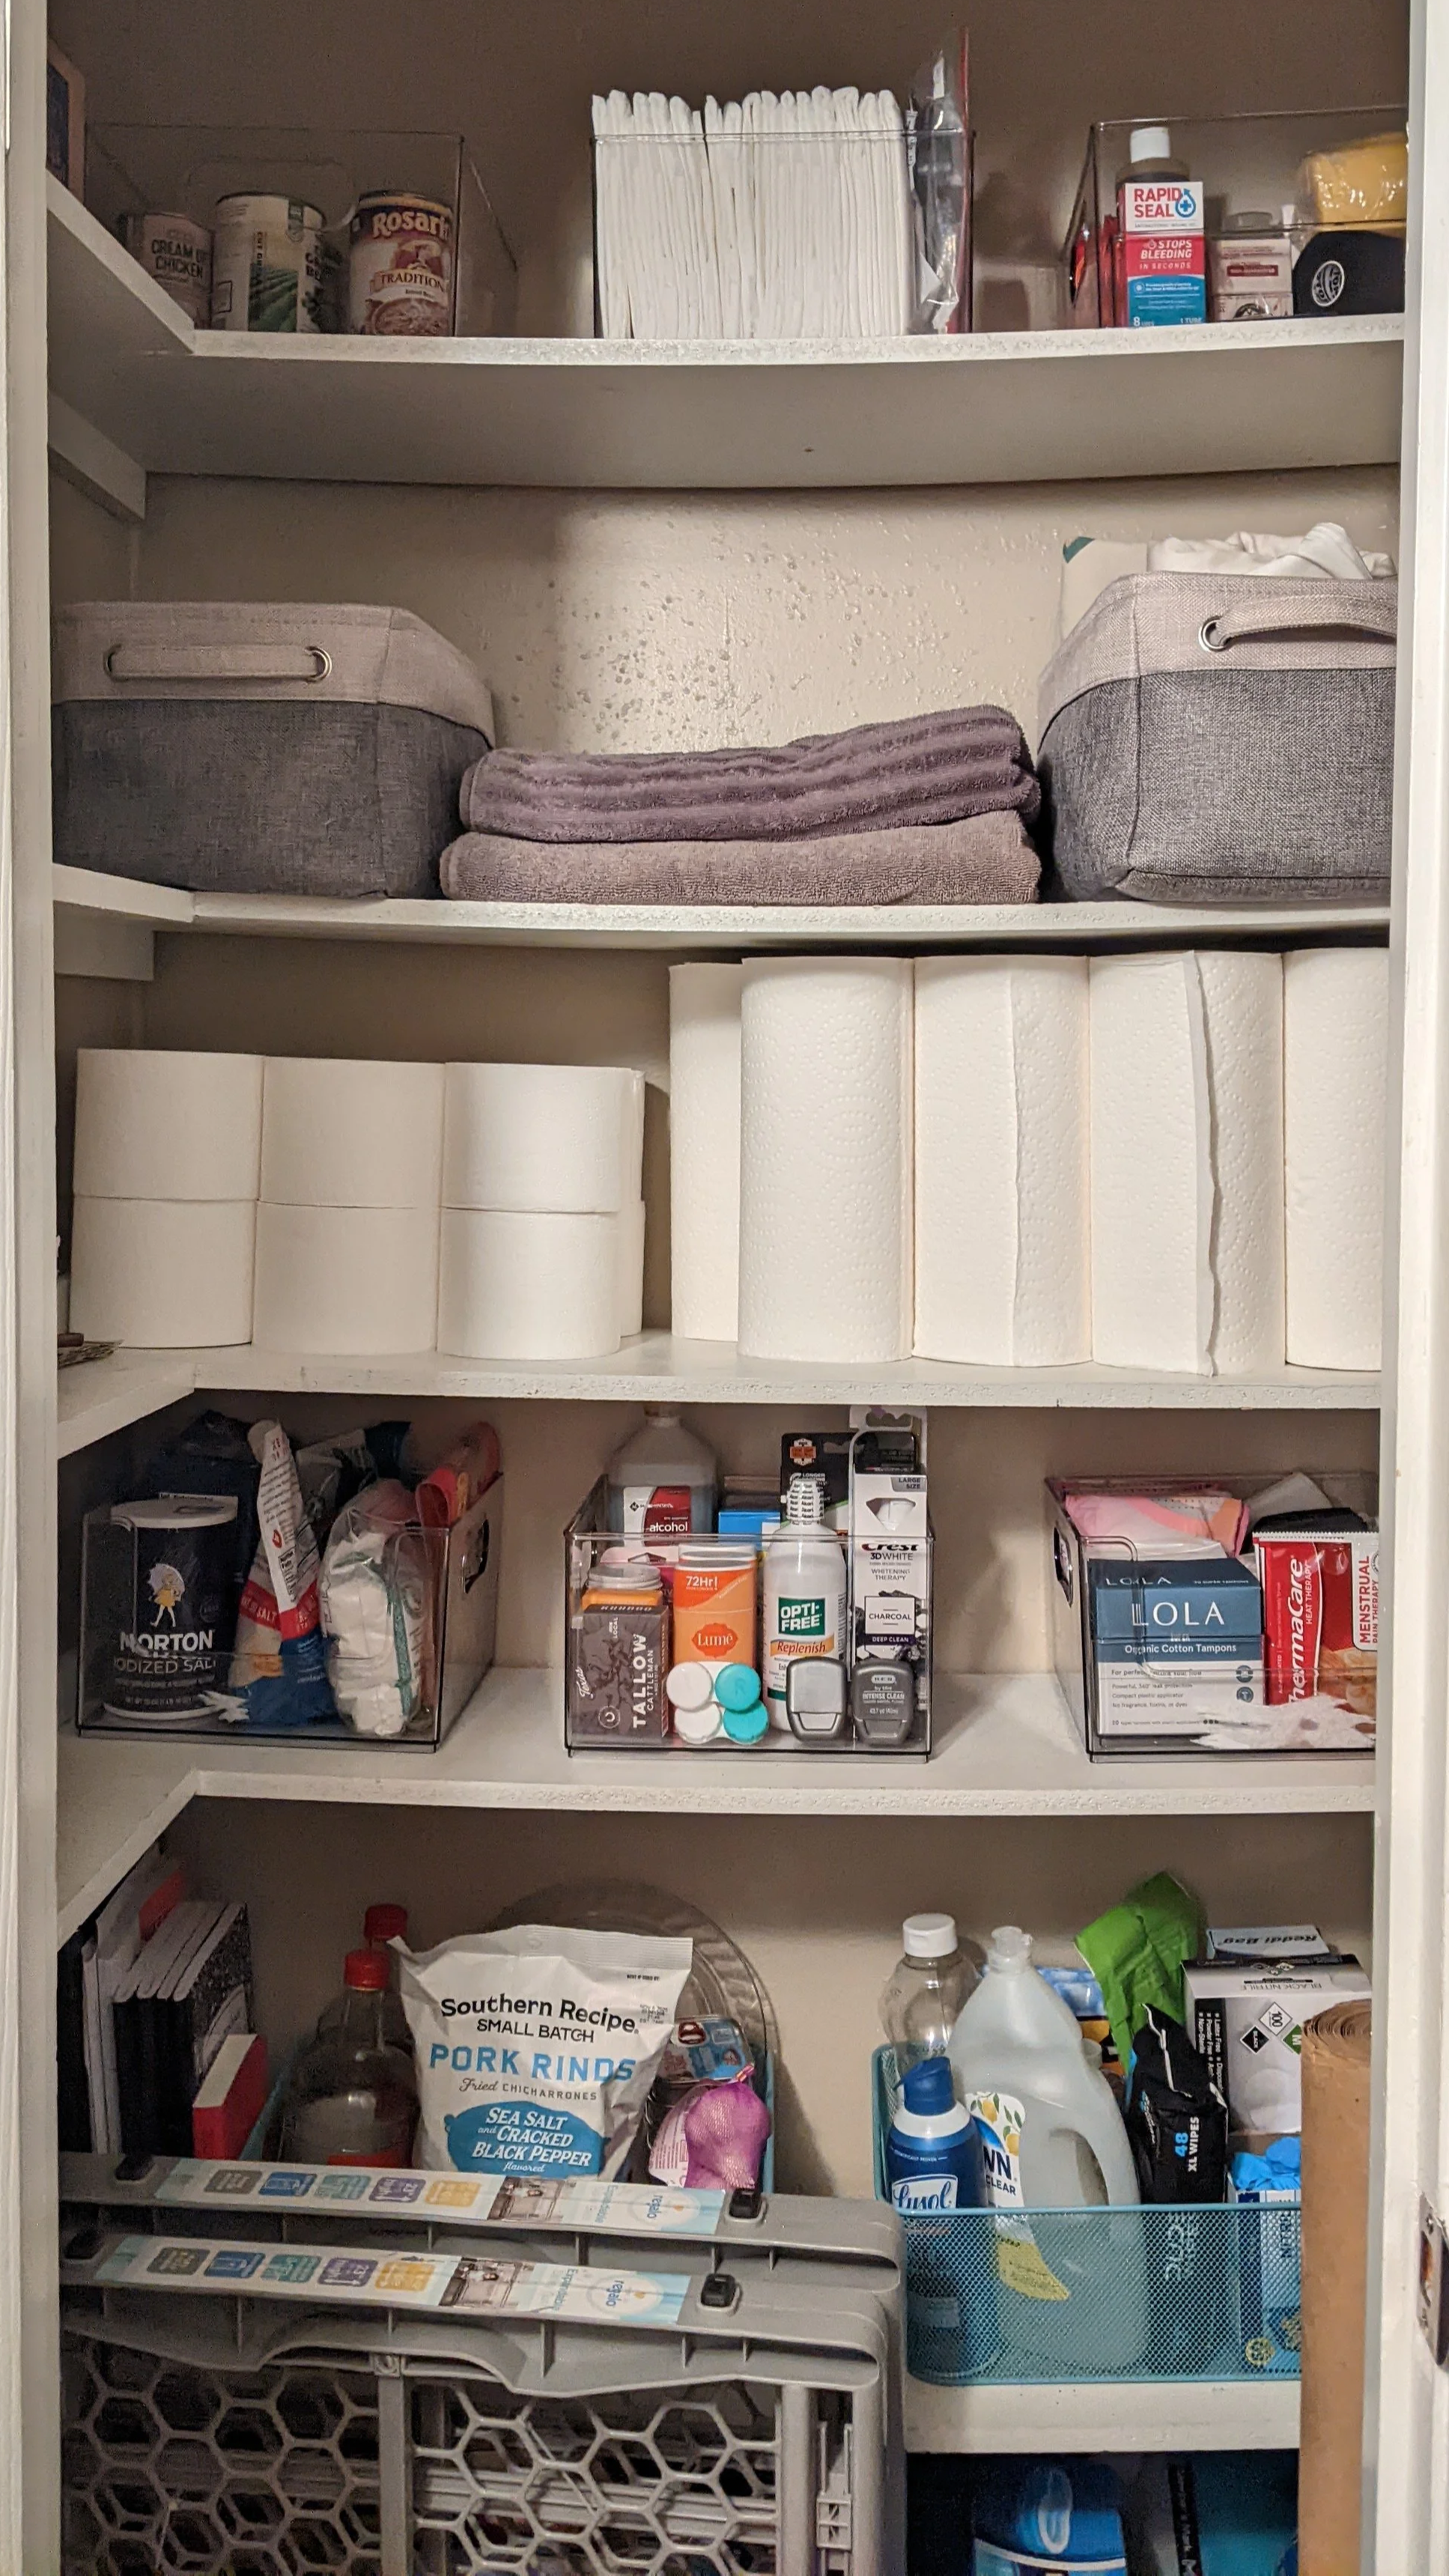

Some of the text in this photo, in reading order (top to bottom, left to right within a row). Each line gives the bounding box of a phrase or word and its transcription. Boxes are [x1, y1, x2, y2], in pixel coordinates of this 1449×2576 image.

[1134, 188, 1181, 202] RAPID
[1134, 204, 1174, 218] SEAL
[372, 211, 449, 240] Rosari
[151, 239, 193, 258] CREAM
[1140, 249, 1192, 260] BLEEDING
[1158, 239, 1192, 249] STOPS
[156, 255, 204, 279] CHICKEN
[380, 272, 444, 293] TRADITION
[1133, 316, 1140, 326] 8
[649, 1521, 688, 1532] alcohol
[861, 1543, 919, 1551] Crest
[780, 1602, 820, 1619] OPTI-
[1359, 1556, 1371, 1644] MENSTRUAL
[780, 1614, 821, 1632] FREE
[1131, 1601, 1225, 1626] LOLA
[1287, 1555, 1305, 1704] hermaCare
[777, 1641, 826, 1656] Replenish
[1161, 1644, 1194, 1653] Cotton
[1195, 1643, 1237, 1656] Tampons
[633, 1633, 647, 1728] TALLOW
[1222, 1934, 1318, 1945] Reddi Bag
[440, 1993, 553, 2017] Southern
[477, 2018, 595, 2044] SMALL BATCH
[1272, 2011, 1283, 2028] 100
[1292, 2034, 1301, 2046] M
[430, 2043, 637, 2083] PORK RINDS
[459, 2077, 598, 2100] Fried CHICHARRONES
[486, 2107, 568, 2131] SEA SALT
[478, 2125, 574, 2148] and CRACKED
[1174, 2132, 1189, 2157] 48
[1188, 2116, 1200, 2172] XL WIPES
[471, 2141, 592, 2167] BLACK PEPPER
[982, 2146, 1012, 2181] WN
[502, 2161, 545, 2172] flavored
[893, 2181, 952, 2209] Lysol
[985, 2175, 1016, 2196] CLEAR
[646, 2194, 663, 2220] regalo
[605, 2279, 625, 2308] regalo
